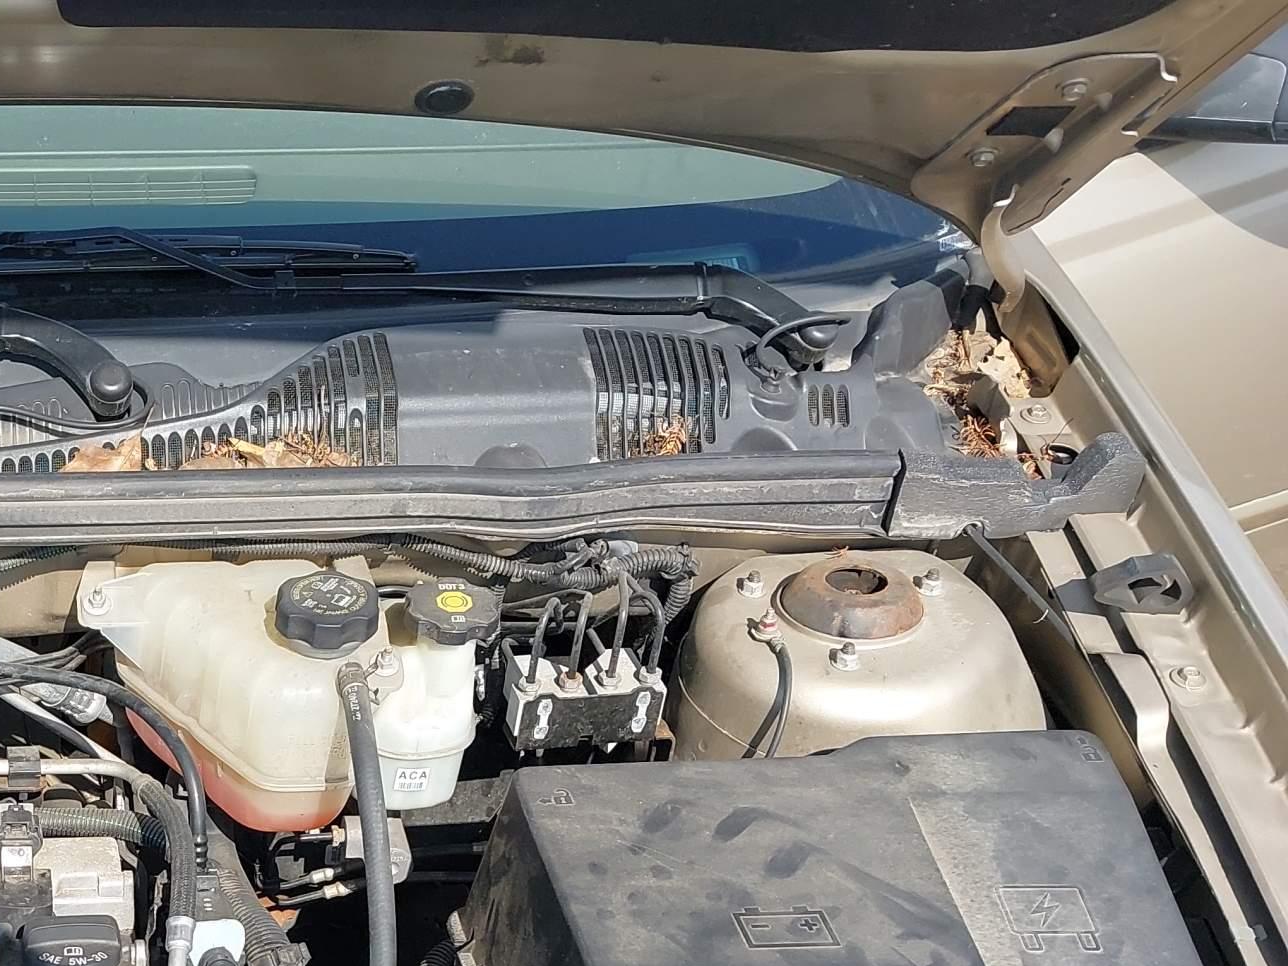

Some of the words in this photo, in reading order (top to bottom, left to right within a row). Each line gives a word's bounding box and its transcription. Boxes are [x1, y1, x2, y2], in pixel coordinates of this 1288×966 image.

[398, 770, 427, 780] ACA
[38, 952, 63, 965] SAE
[68, 951, 109, 966] 5W-30
